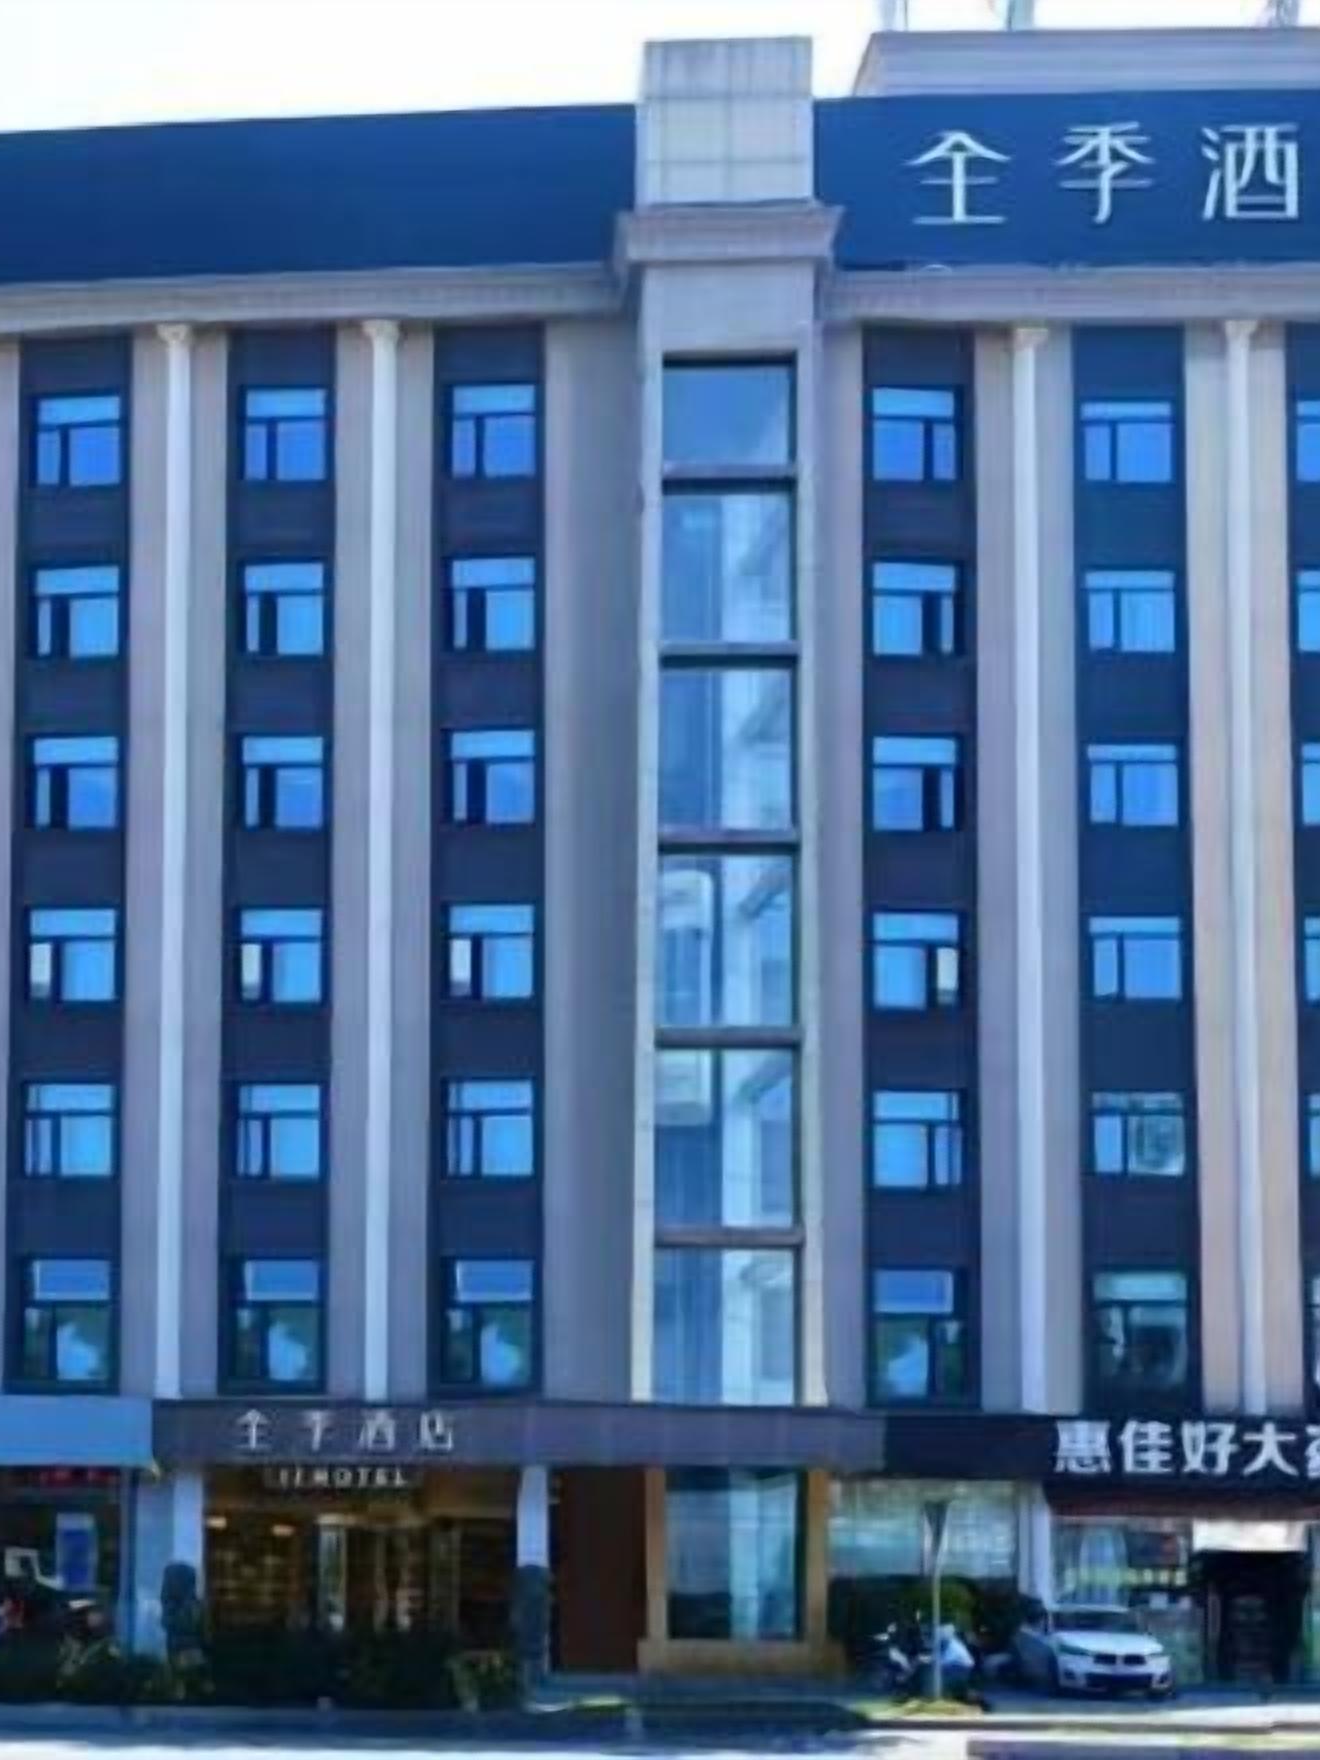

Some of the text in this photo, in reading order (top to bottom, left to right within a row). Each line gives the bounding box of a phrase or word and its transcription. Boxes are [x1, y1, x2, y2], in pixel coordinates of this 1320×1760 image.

[903, 121, 1299, 224] 全季酒
[1054, 1419, 1320, 1478] 惠佳好大
